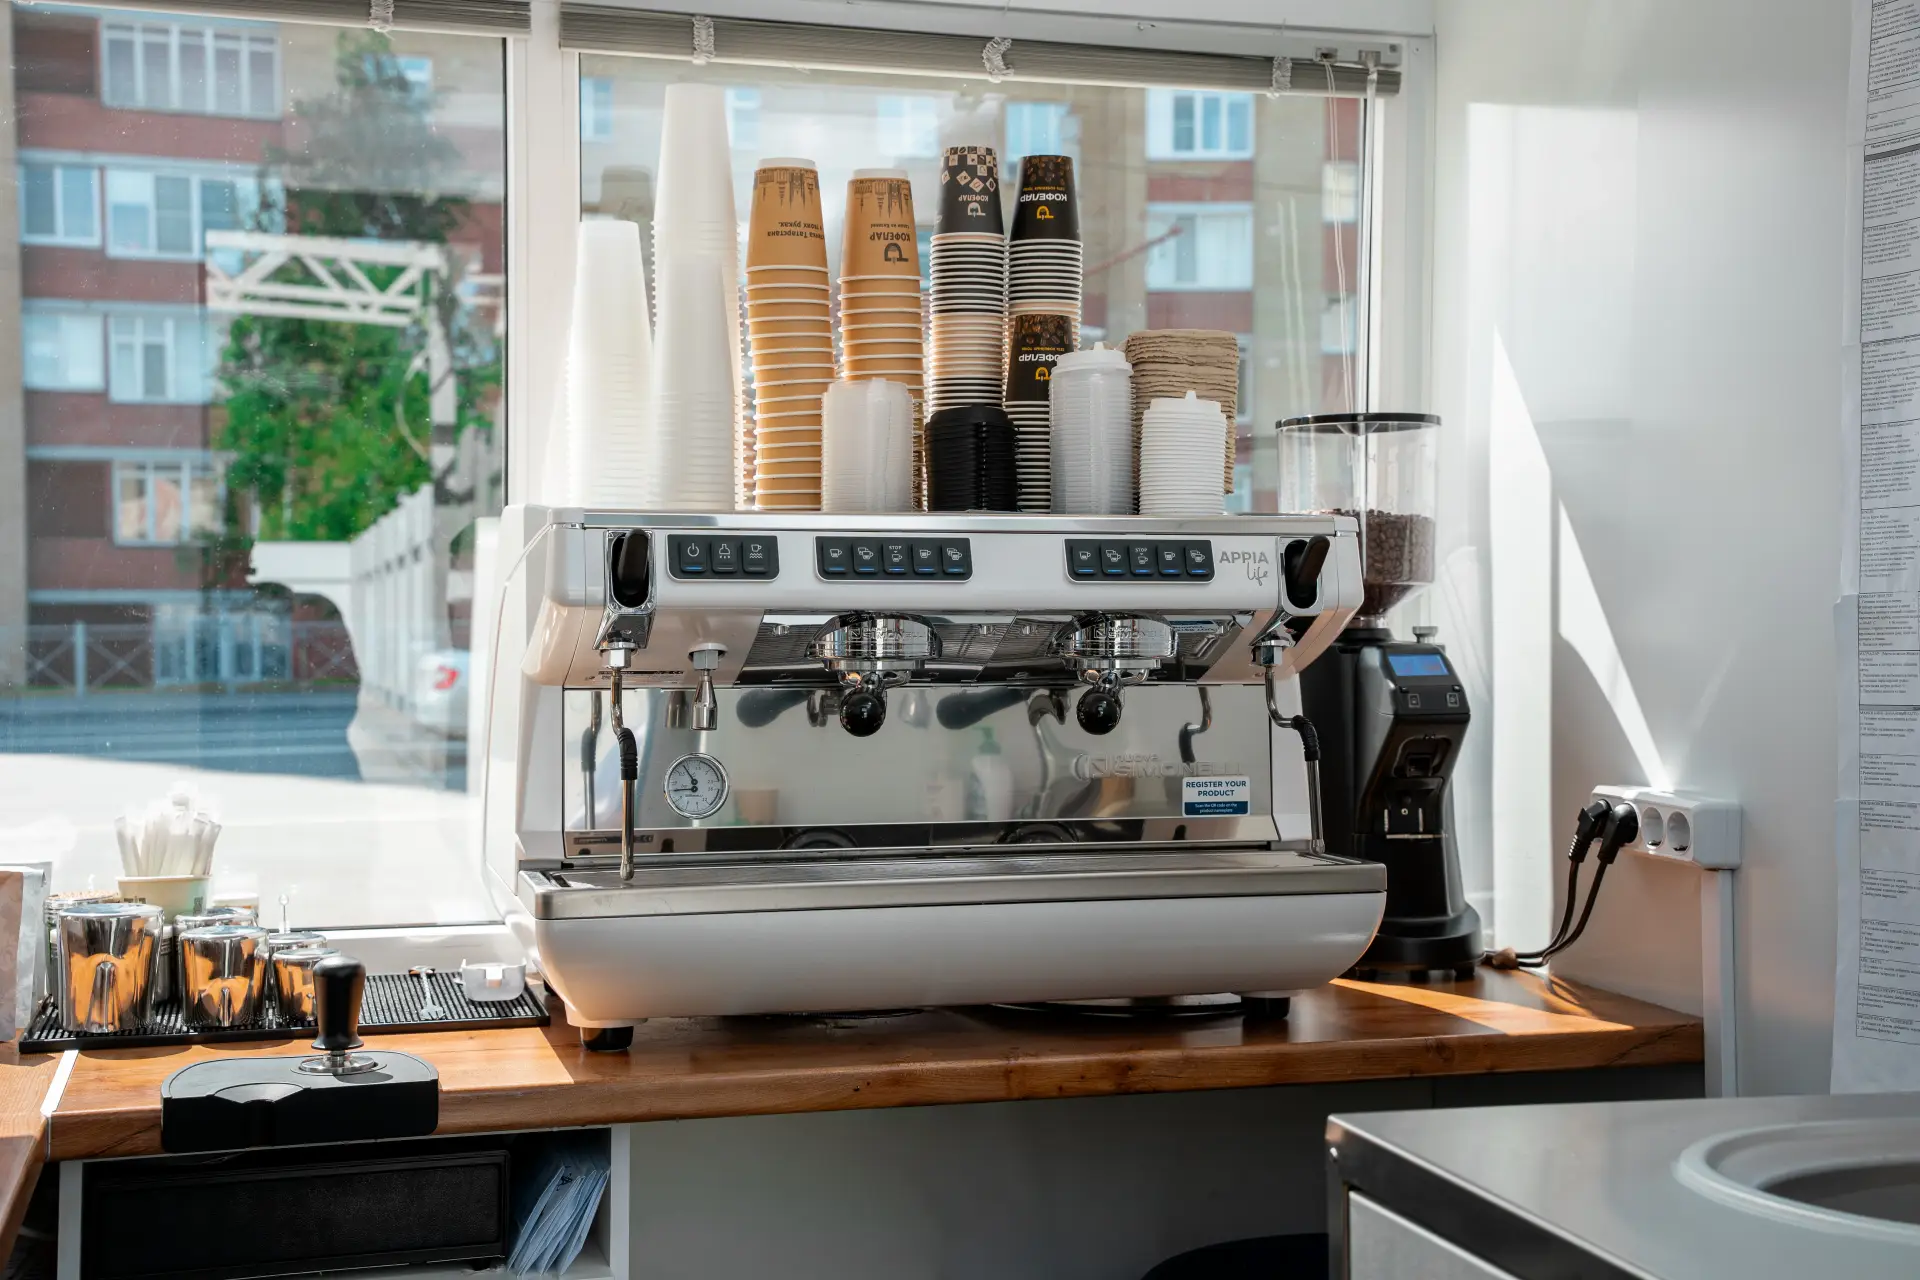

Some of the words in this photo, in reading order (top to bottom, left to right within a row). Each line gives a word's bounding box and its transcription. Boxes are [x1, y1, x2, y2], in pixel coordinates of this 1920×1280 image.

[958, 194, 989, 202] КОФЕЛАР
[1019, 192, 1068, 202] КОФЕЛАР
[778, 220, 802, 229] руках.
[767, 230, 808, 239] Татарстана
[869, 231, 911, 242] КОФЕЛАР
[1018, 353, 1061, 362] ОФЕЛАР
[1218, 550, 1269, 564] APPIA
[1245, 561, 1269, 586] life
[1185, 780, 1223, 788] REGISTER
[1225, 780, 1247, 788] YOUR
[1197, 789, 1235, 797] PRODUCT
